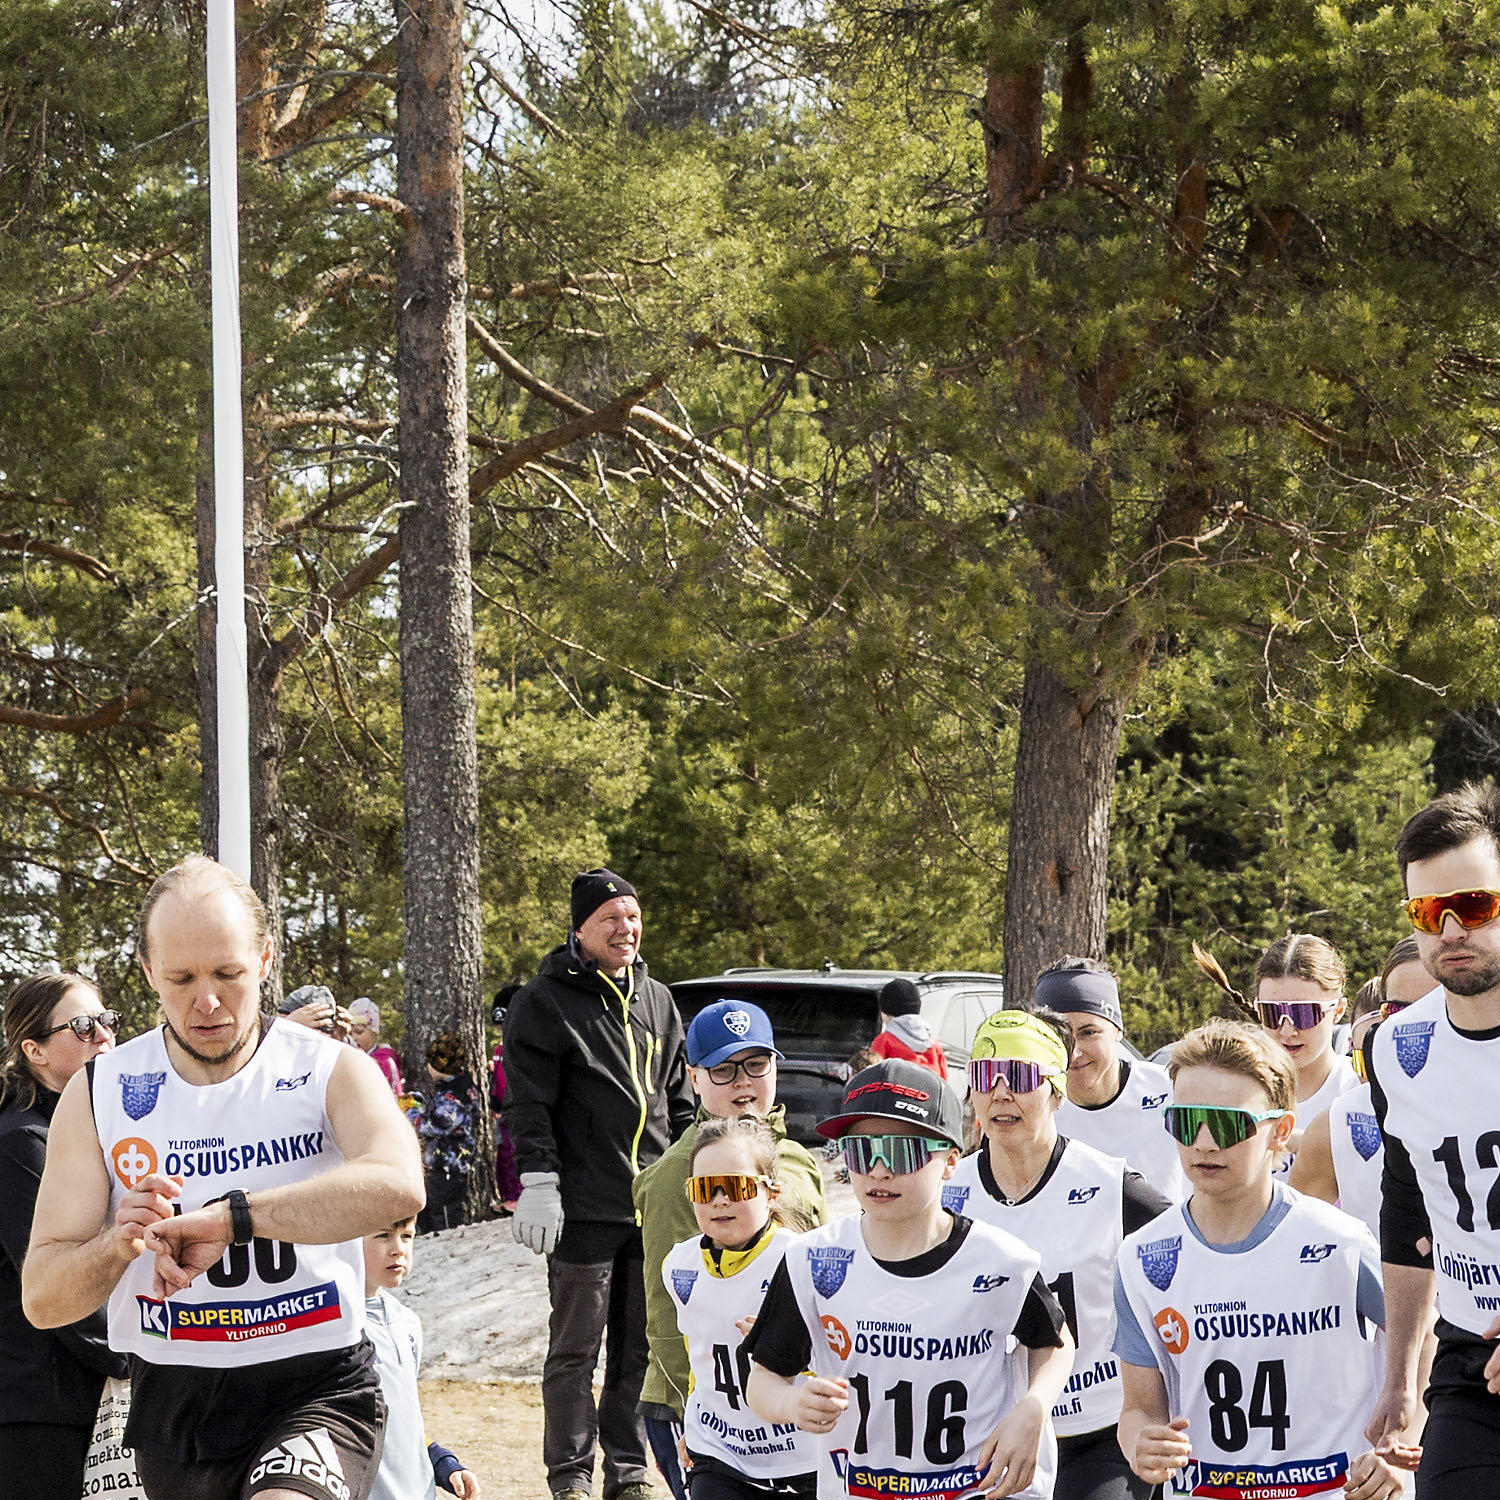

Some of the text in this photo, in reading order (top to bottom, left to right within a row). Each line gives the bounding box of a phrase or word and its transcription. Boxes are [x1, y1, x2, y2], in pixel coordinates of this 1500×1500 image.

[1401, 1024, 1428, 1035] KUOHU
[1406, 1037, 1421, 1046] 1913
[168, 1137, 225, 1150] YLITORNION
[165, 1132, 324, 1177] OSUUSPANKKI
[143, 1291, 328, 1331] K SUPERMARKET
[1194, 1301, 1247, 1315] YLITORNION
[226, 1323, 287, 1341] YLITORNIO
[856, 1320, 912, 1334] YLITORNION
[1194, 1305, 1341, 1341] OSUUSPANKKI
[1063, 1361, 1118, 1394] uohu
[1204, 1359, 1291, 1453] 84
[848, 1372, 968, 1465] 116
[1207, 1462, 1338, 1486] SUPERMARKET
[1240, 1487, 1298, 1500] YLITORNIO
